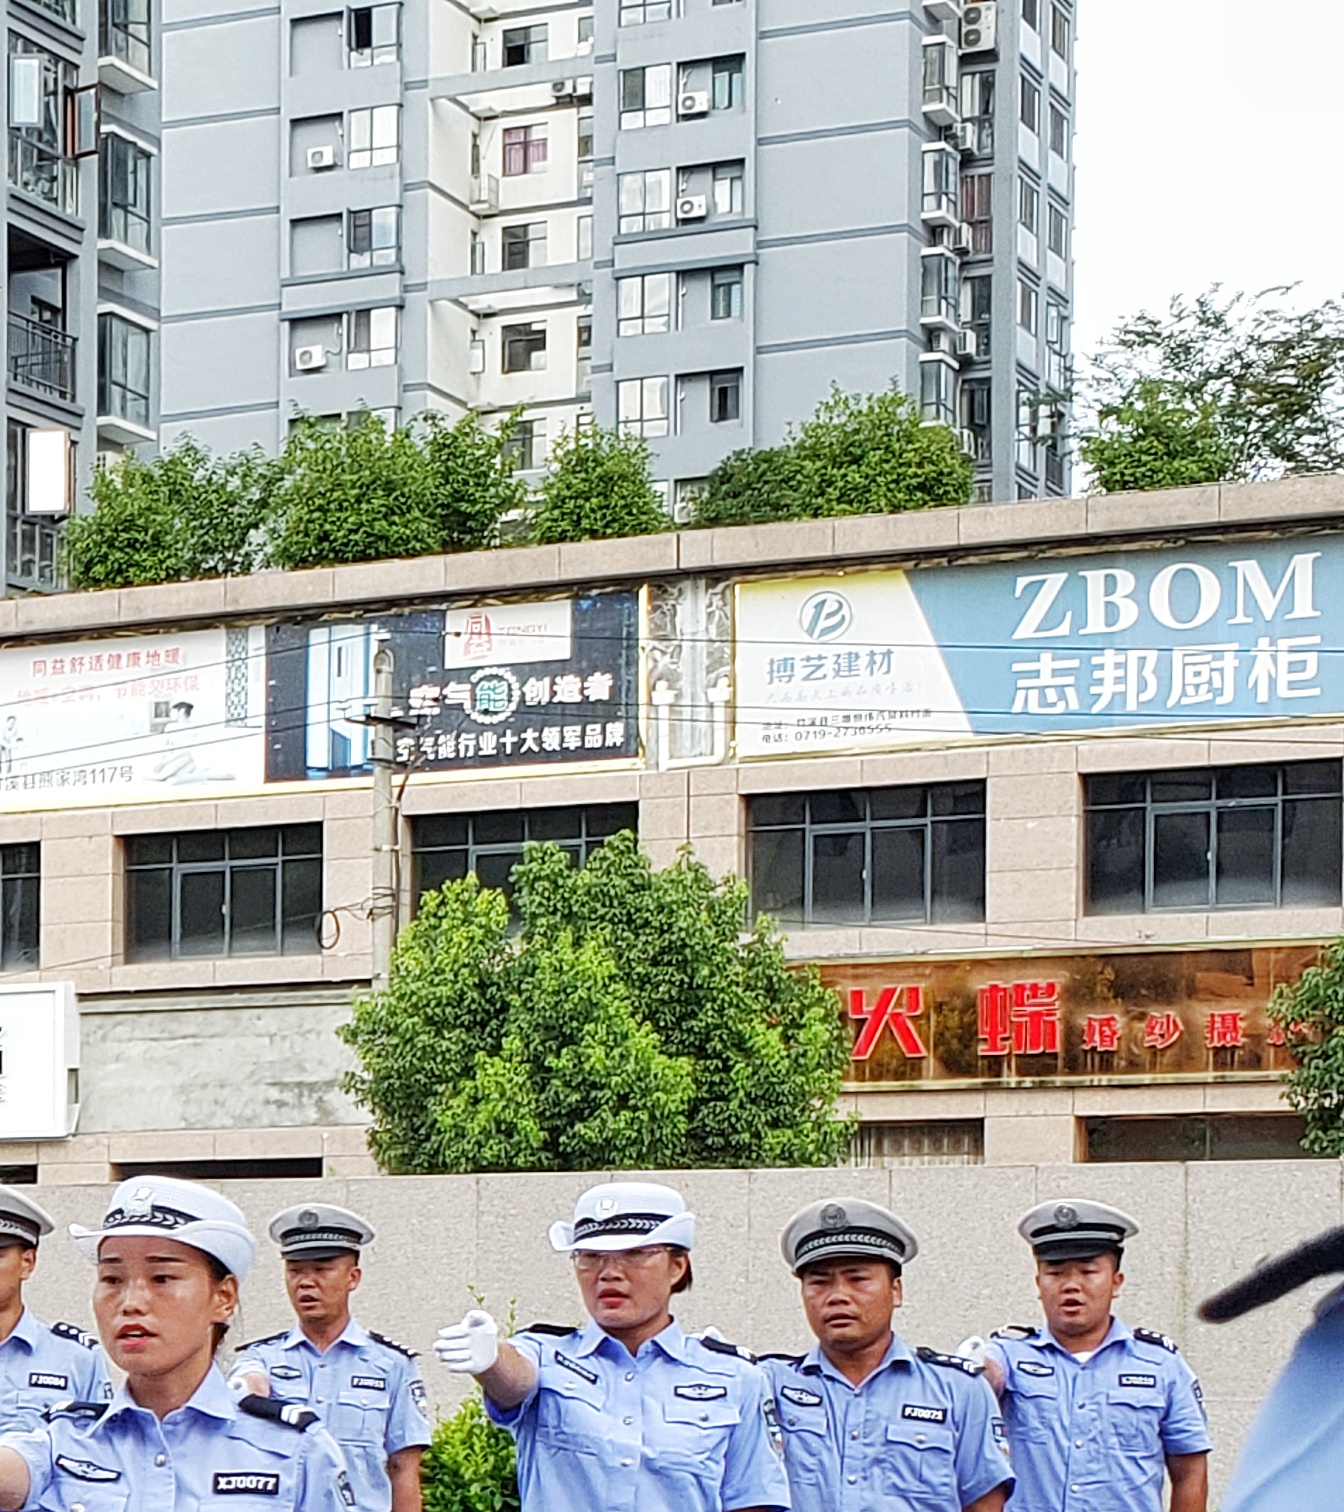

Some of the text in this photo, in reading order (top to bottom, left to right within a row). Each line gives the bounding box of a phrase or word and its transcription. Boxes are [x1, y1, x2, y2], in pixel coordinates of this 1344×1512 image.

[1012, 552, 1322, 640] ZBOM
[1011, 634, 1322, 715] 志邦厨柜
[217, 1477, 276, 1492] XJ0077
